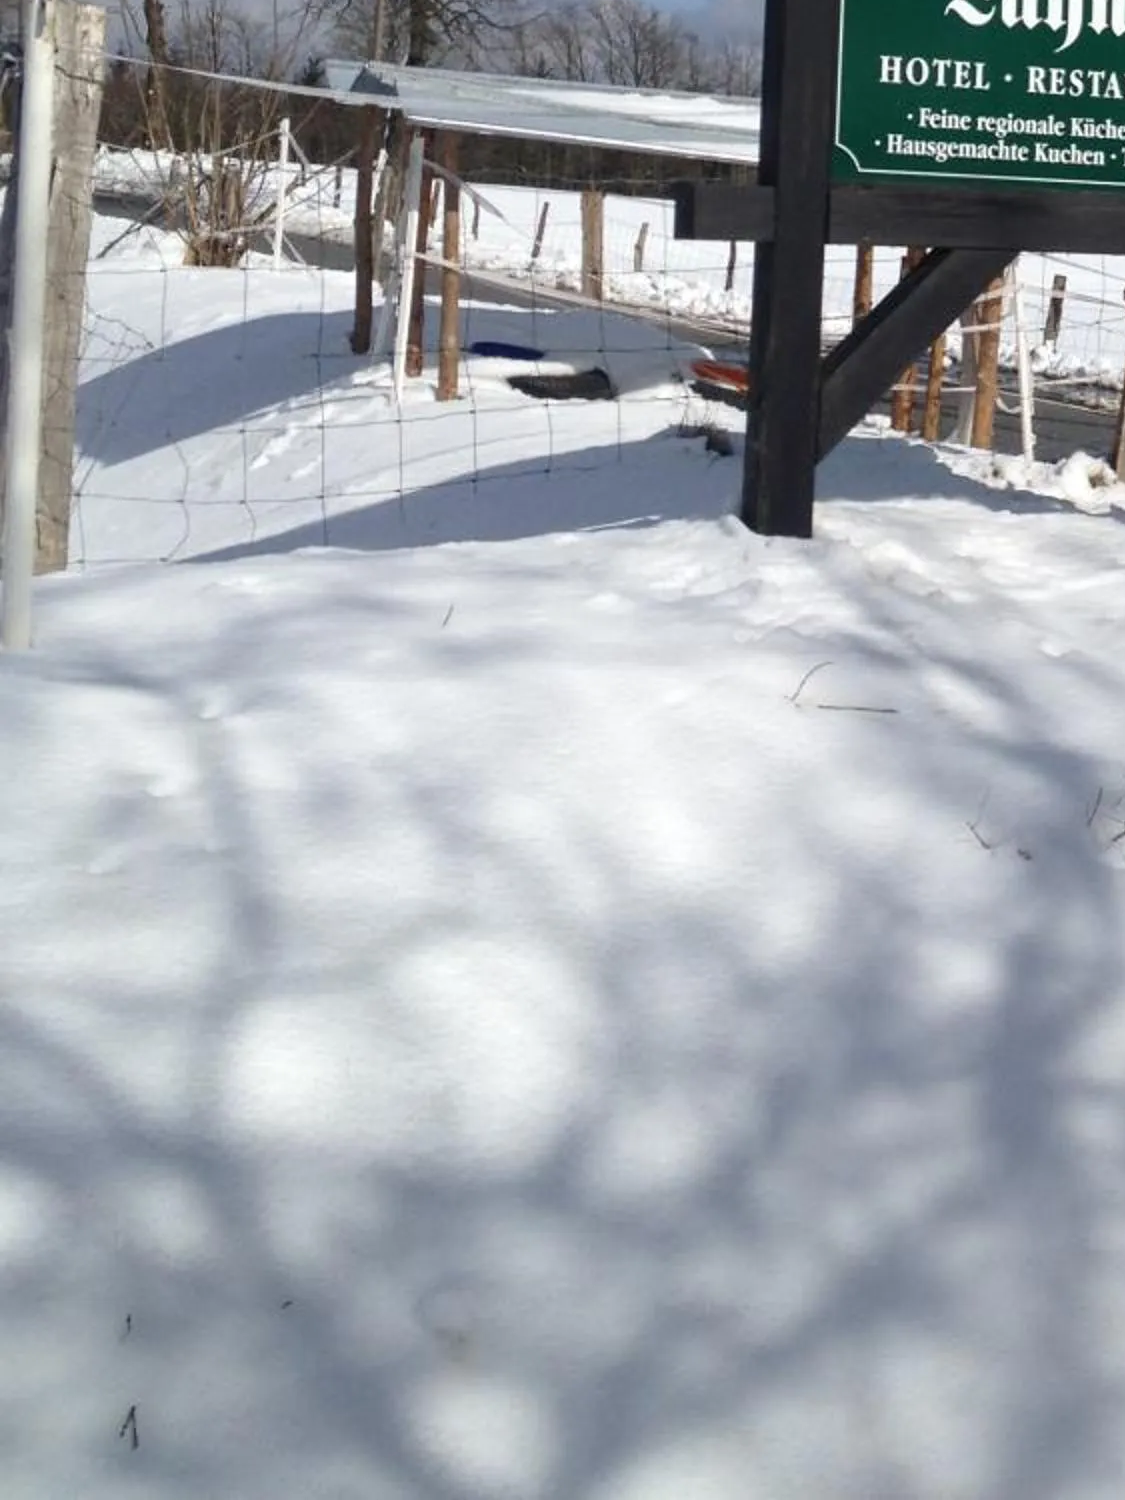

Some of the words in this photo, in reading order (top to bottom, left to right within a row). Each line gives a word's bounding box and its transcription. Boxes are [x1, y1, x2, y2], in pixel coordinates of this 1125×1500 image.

[879, 54, 991, 91] HOTEL
[918, 107, 972, 131] Feine
[976, 112, 1066, 139] regionale
[886, 133, 1030, 163] Hausgemachte
[1034, 141, 1106, 166] Kuchen
